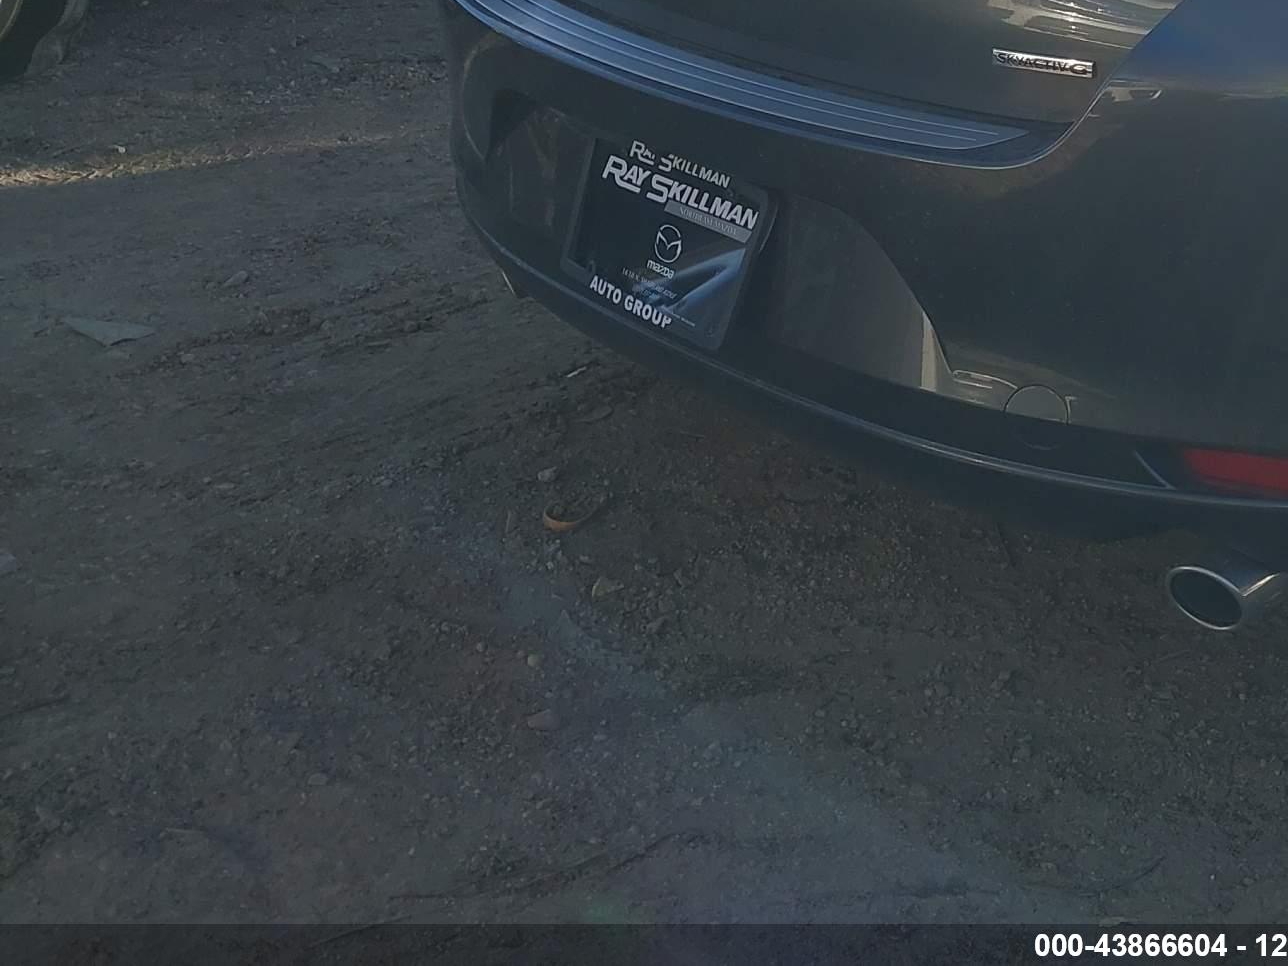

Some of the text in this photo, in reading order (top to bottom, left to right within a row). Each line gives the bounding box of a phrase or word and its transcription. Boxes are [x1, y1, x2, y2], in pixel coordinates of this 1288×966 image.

[602, 155, 759, 230] RAY SKILLMAN
[659, 153, 732, 189] SKILLMAN
[589, 274, 622, 305] AUTO
[624, 296, 673, 330] GROUP
